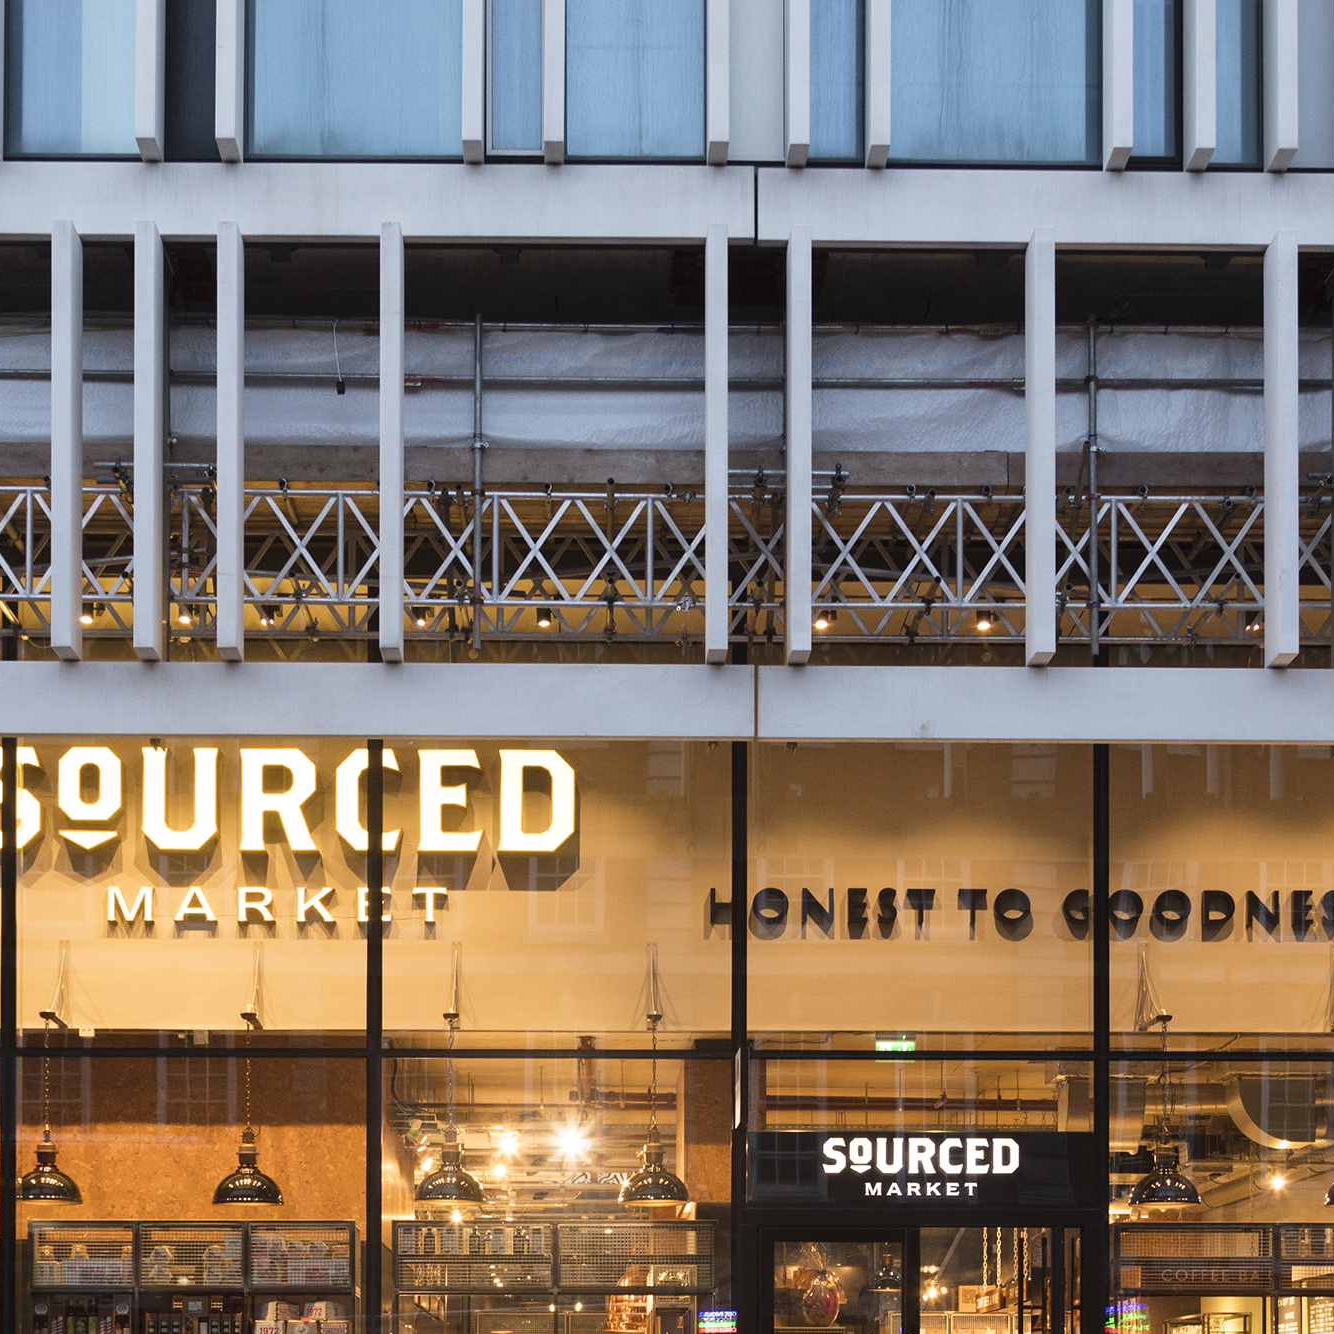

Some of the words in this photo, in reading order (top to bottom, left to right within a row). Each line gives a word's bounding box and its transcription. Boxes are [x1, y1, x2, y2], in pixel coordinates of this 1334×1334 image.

[106, 885, 449, 922] MARKET
[709, 887, 935, 926] HONEST
[957, 888, 1031, 926] TO
[822, 1137, 1020, 1175] SOURCED
[864, 1182, 979, 1197] MARKET
[1161, 1269, 1229, 1282] COFFEE
[306, 1308, 323, 1317] 1972
